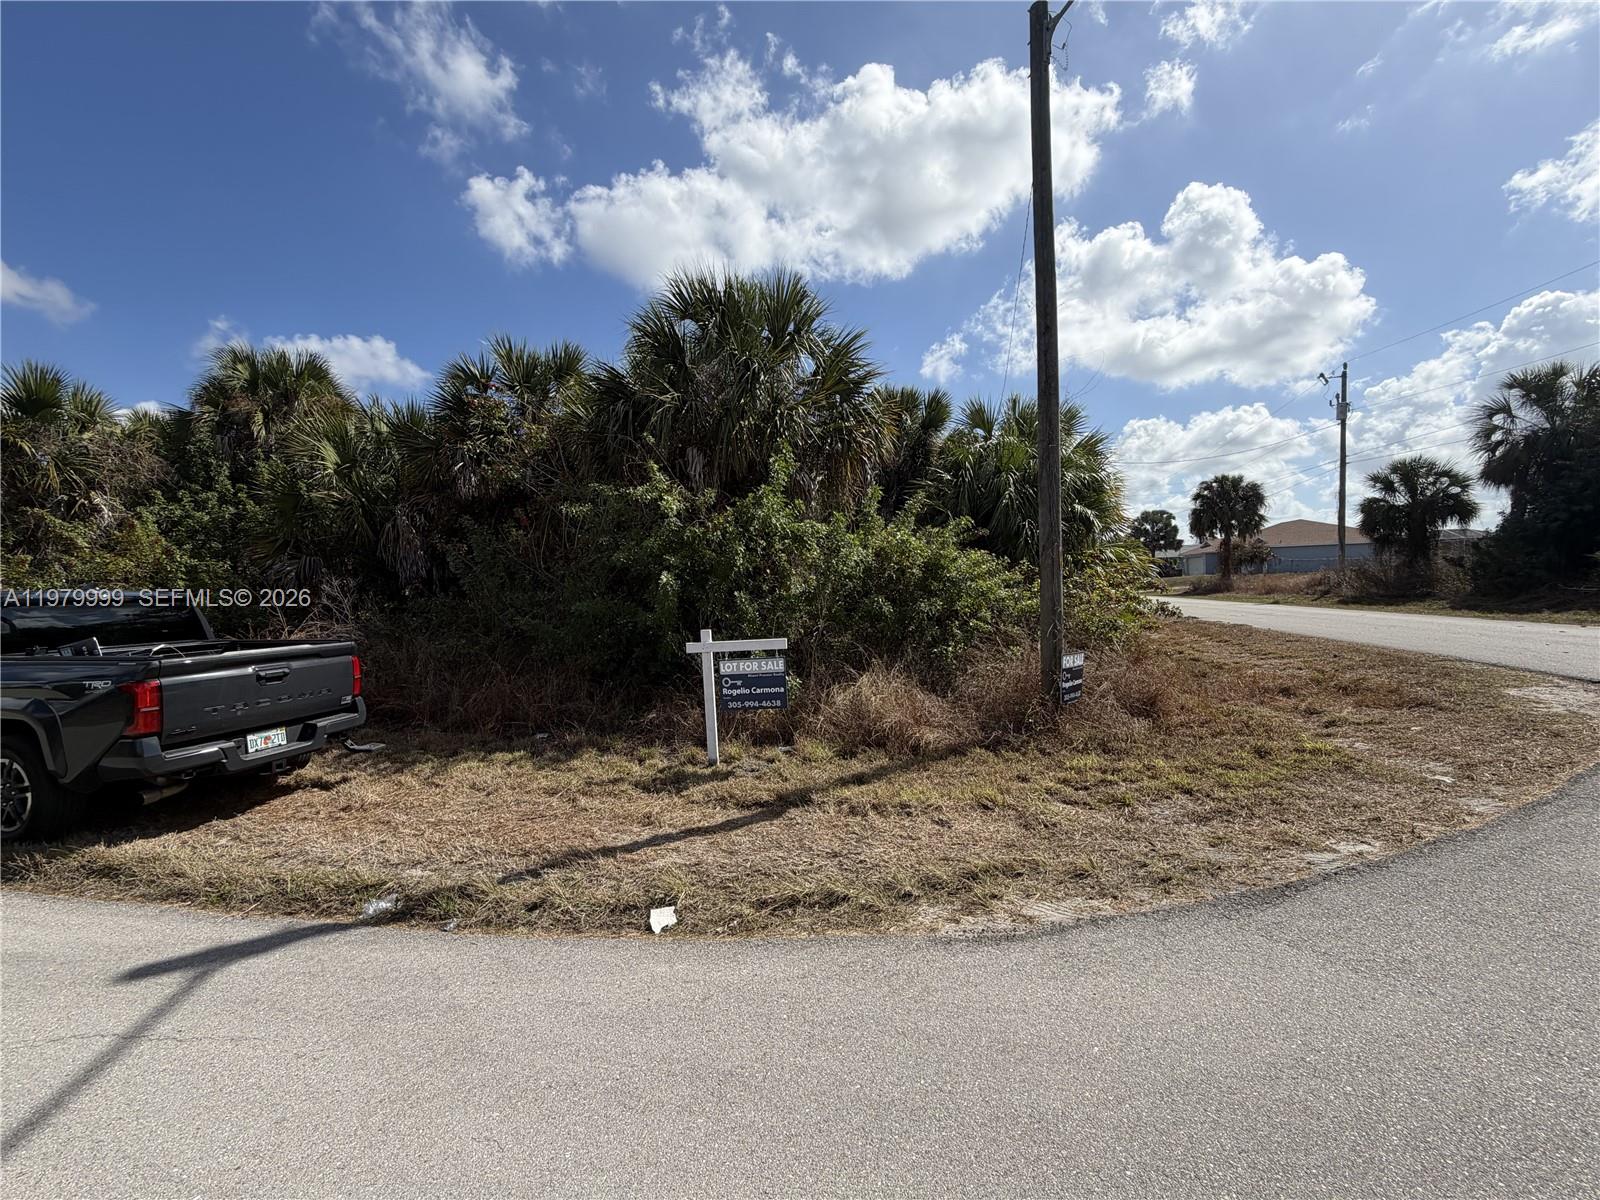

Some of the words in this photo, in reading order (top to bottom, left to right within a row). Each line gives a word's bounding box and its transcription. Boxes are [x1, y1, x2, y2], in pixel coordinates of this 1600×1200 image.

[720, 662, 737, 672] LOT
[740, 661, 758, 671] FOR
[761, 660, 784, 670] SALE
[82, 680, 112, 690] TRD
[722, 687, 750, 696] Rogelio
[751, 686, 785, 694] Carmona
